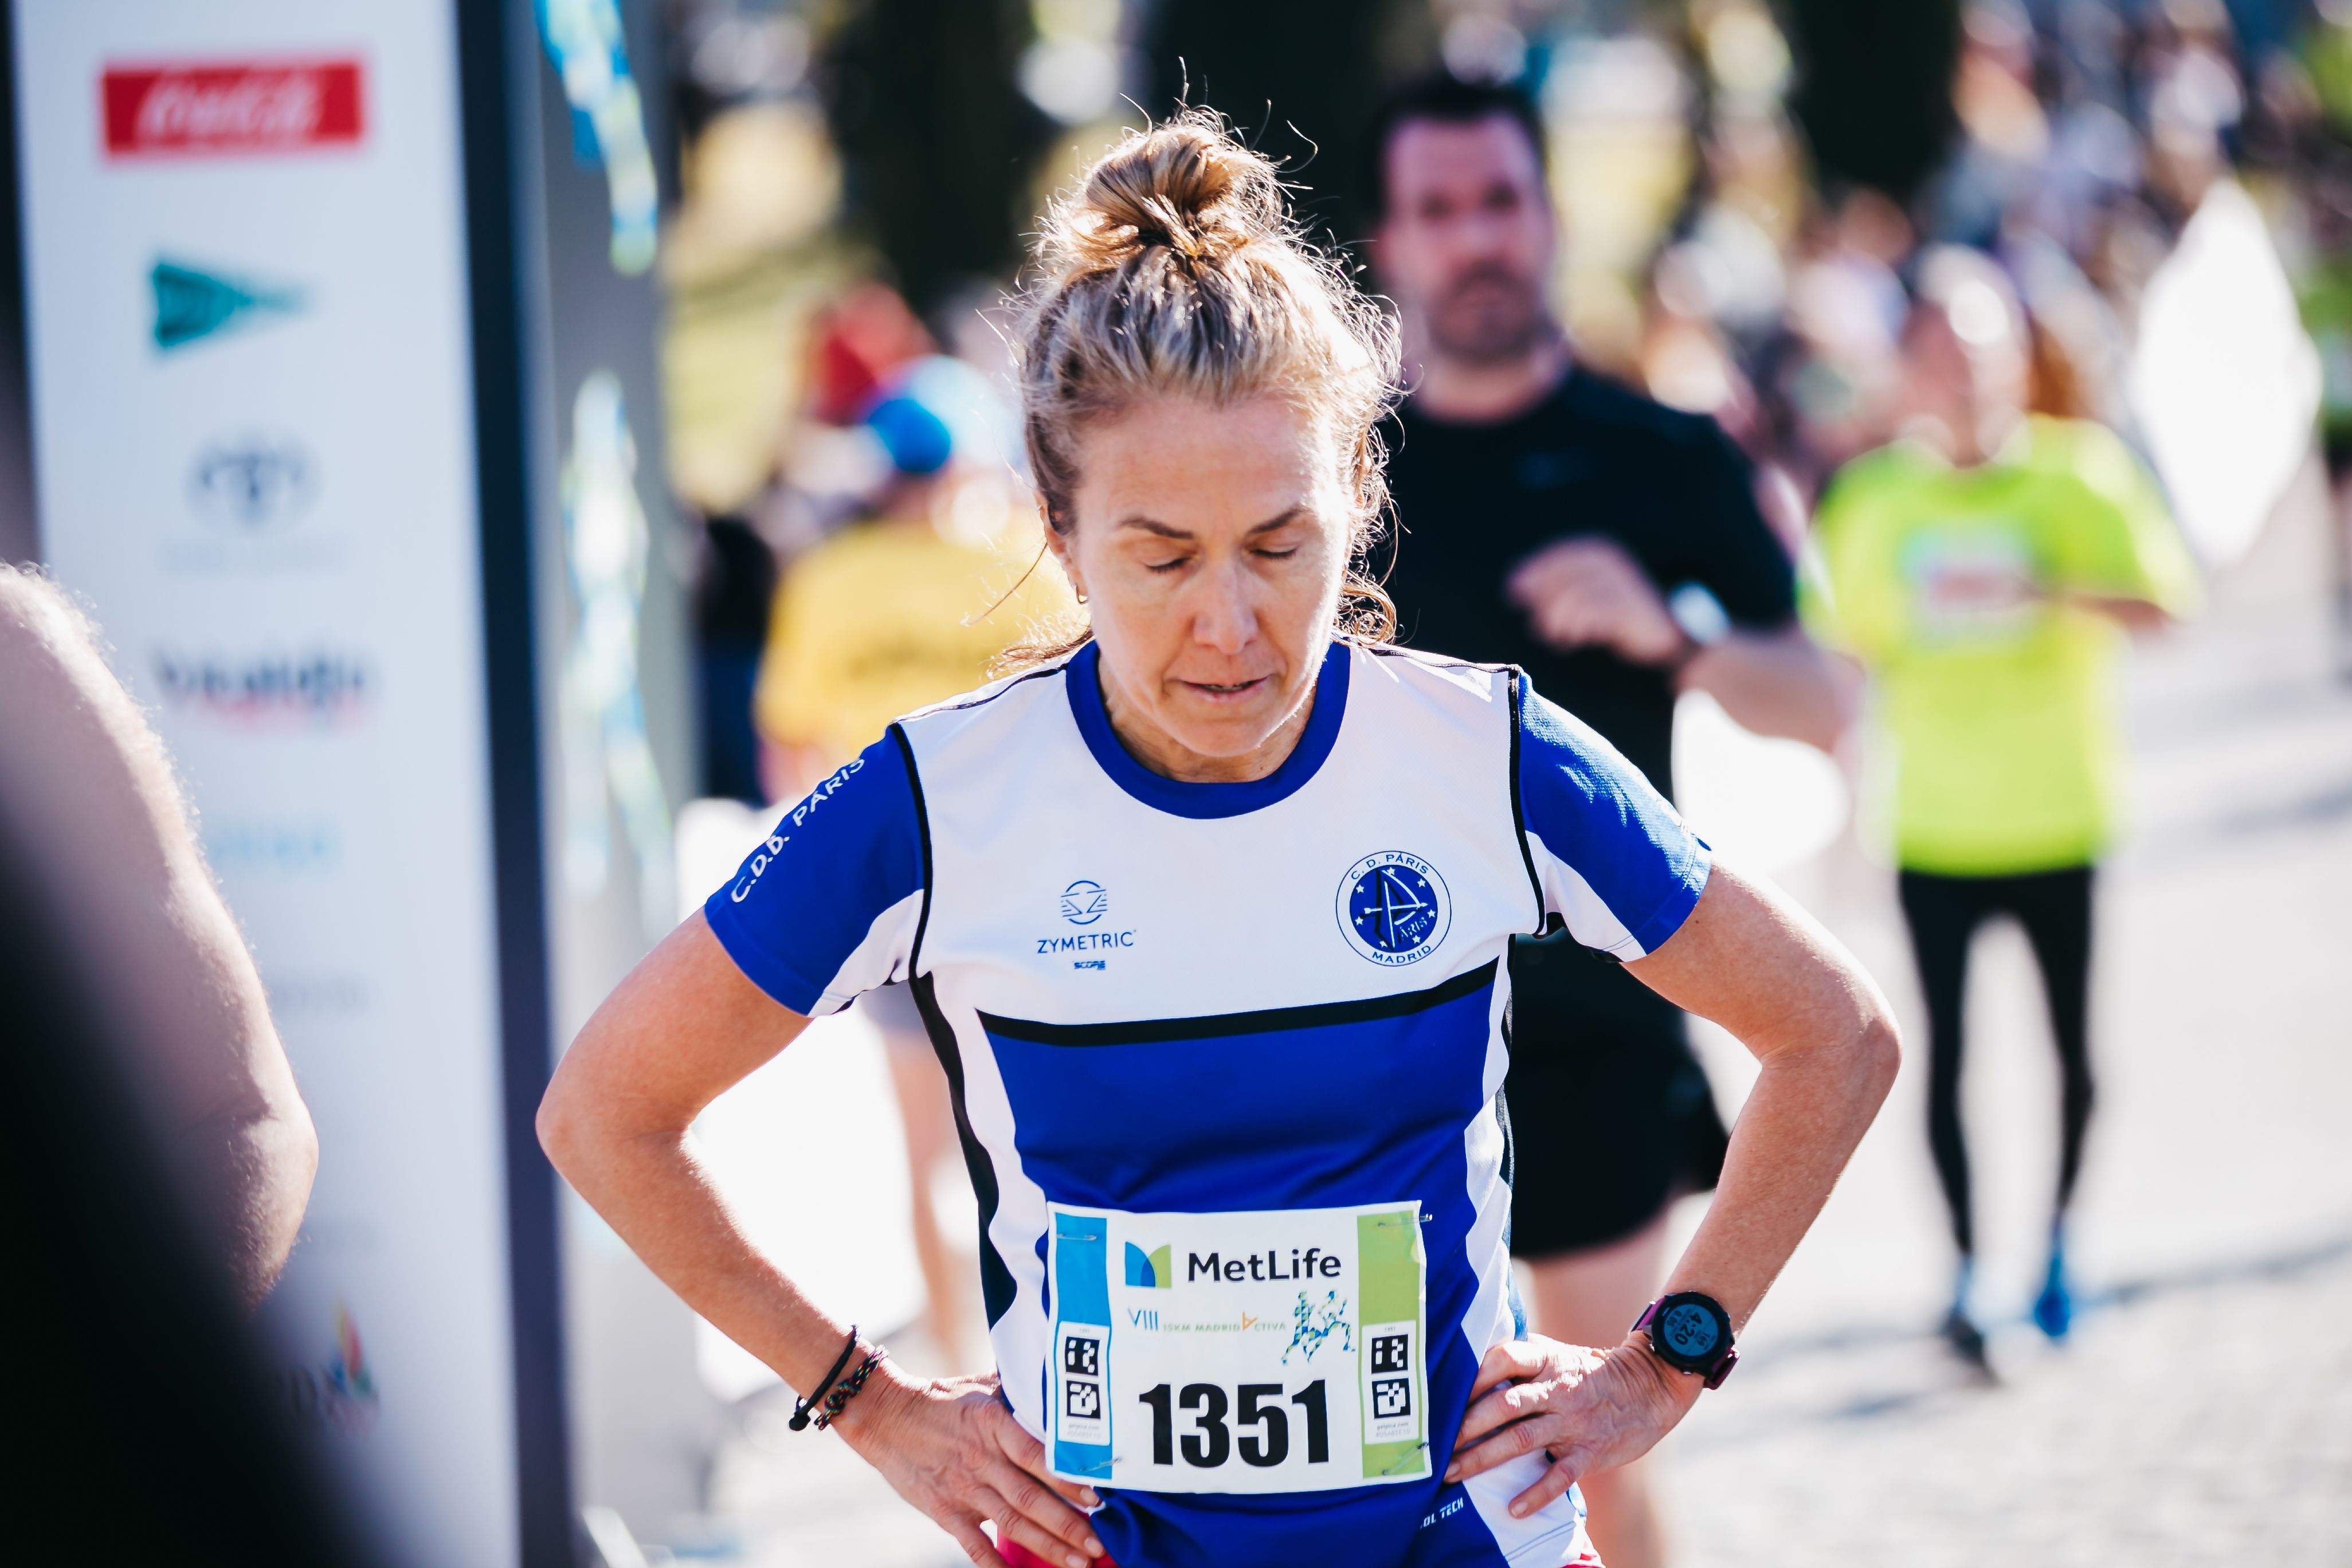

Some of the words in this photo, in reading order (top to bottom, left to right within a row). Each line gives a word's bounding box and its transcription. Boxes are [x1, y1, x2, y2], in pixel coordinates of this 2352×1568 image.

[1386, 852, 1429, 874] PÁRIS
[1037, 931, 1134, 954] ZYMETRIC
[1372, 945, 1431, 963] MADRID
[1187, 1247, 1342, 1283] MetLife
[1127, 1308, 1159, 1331] VIII
[1139, 1379, 1330, 1468] 1351
[1440, 1496, 1464, 1519] TECH
